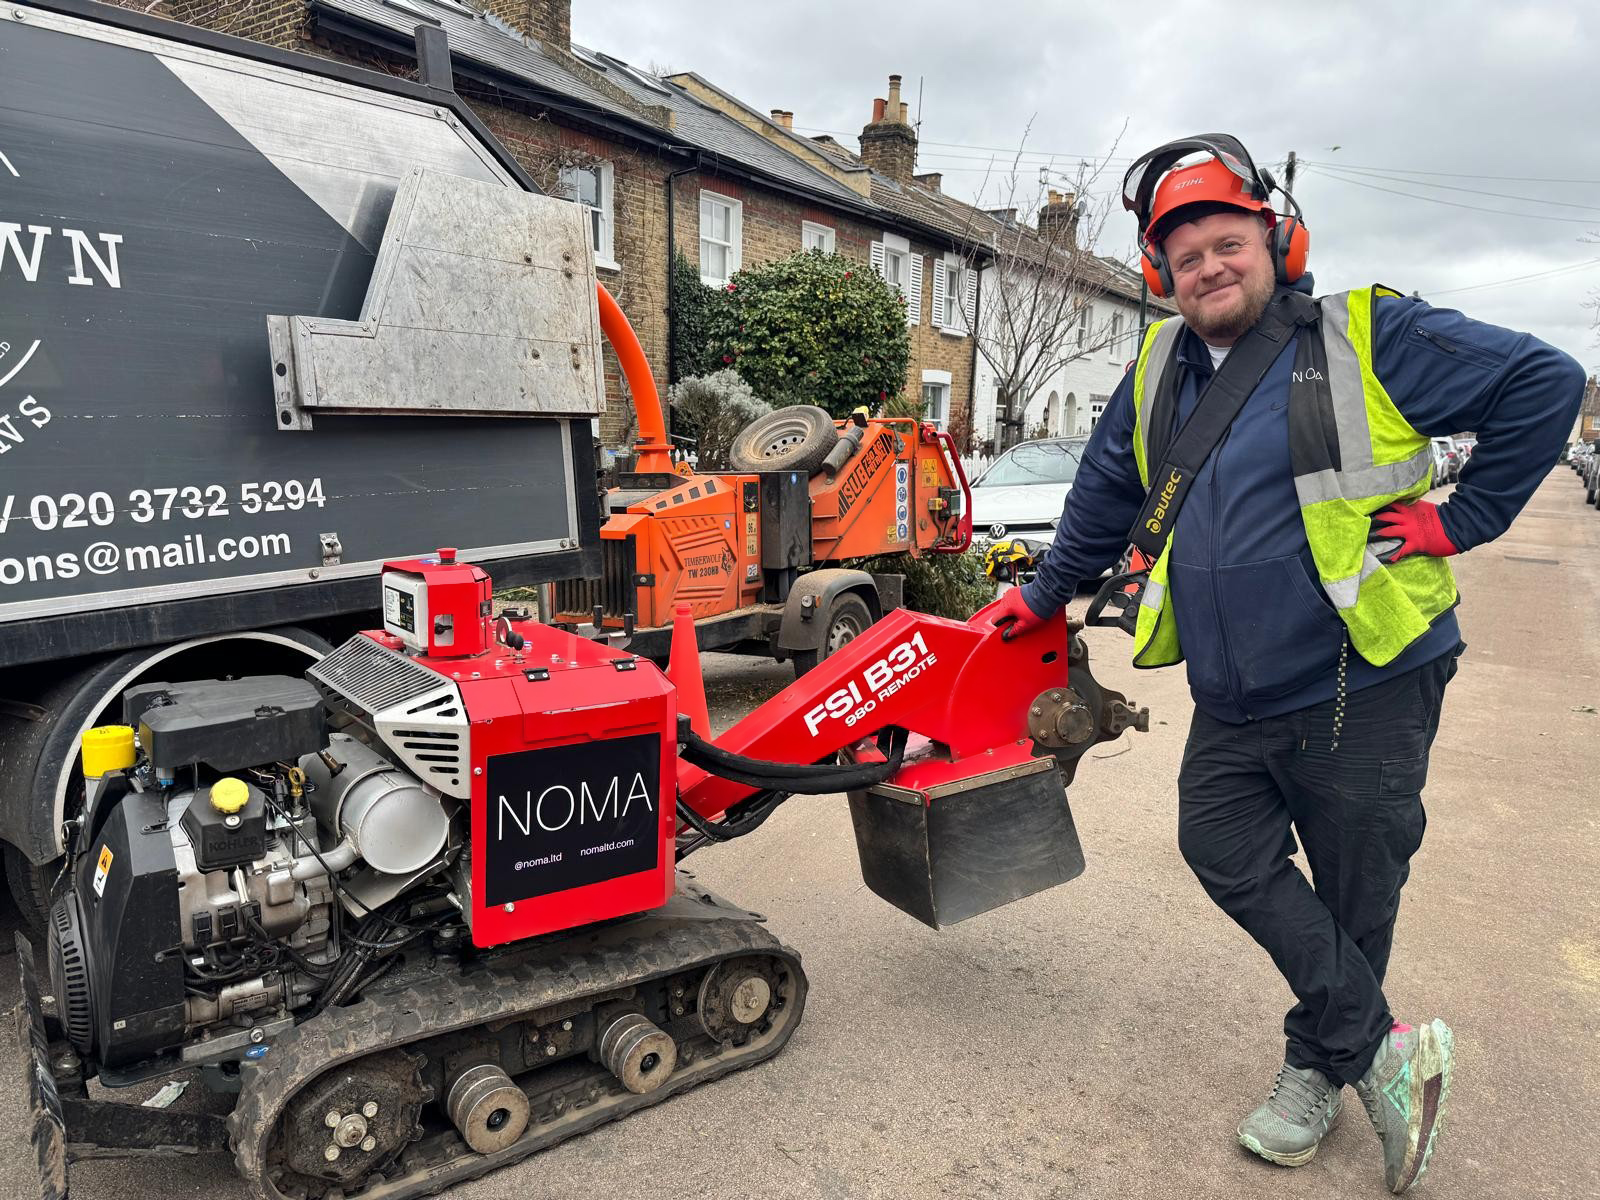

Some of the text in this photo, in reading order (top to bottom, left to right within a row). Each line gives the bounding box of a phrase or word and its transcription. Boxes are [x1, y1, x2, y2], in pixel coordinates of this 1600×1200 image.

[1172, 177, 1204, 192] STIHL
[30, 491, 115, 531] 020
[129, 485, 229, 523] 3732
[241, 478, 326, 514] 5294
[1154, 470, 1182, 520] autec
[0, 533, 291, 585] ons@mail.com
[684, 554, 722, 567] TIMBERWOLF
[688, 569, 698, 578] TW
[803, 631, 928, 737] FSI B31
[845, 653, 938, 727] 980 REMOTE
[498, 772, 653, 841] NOMA
[209, 836, 260, 852] KOHLER
[514, 838, 634, 871] @noma.ltd nomaltd.com
